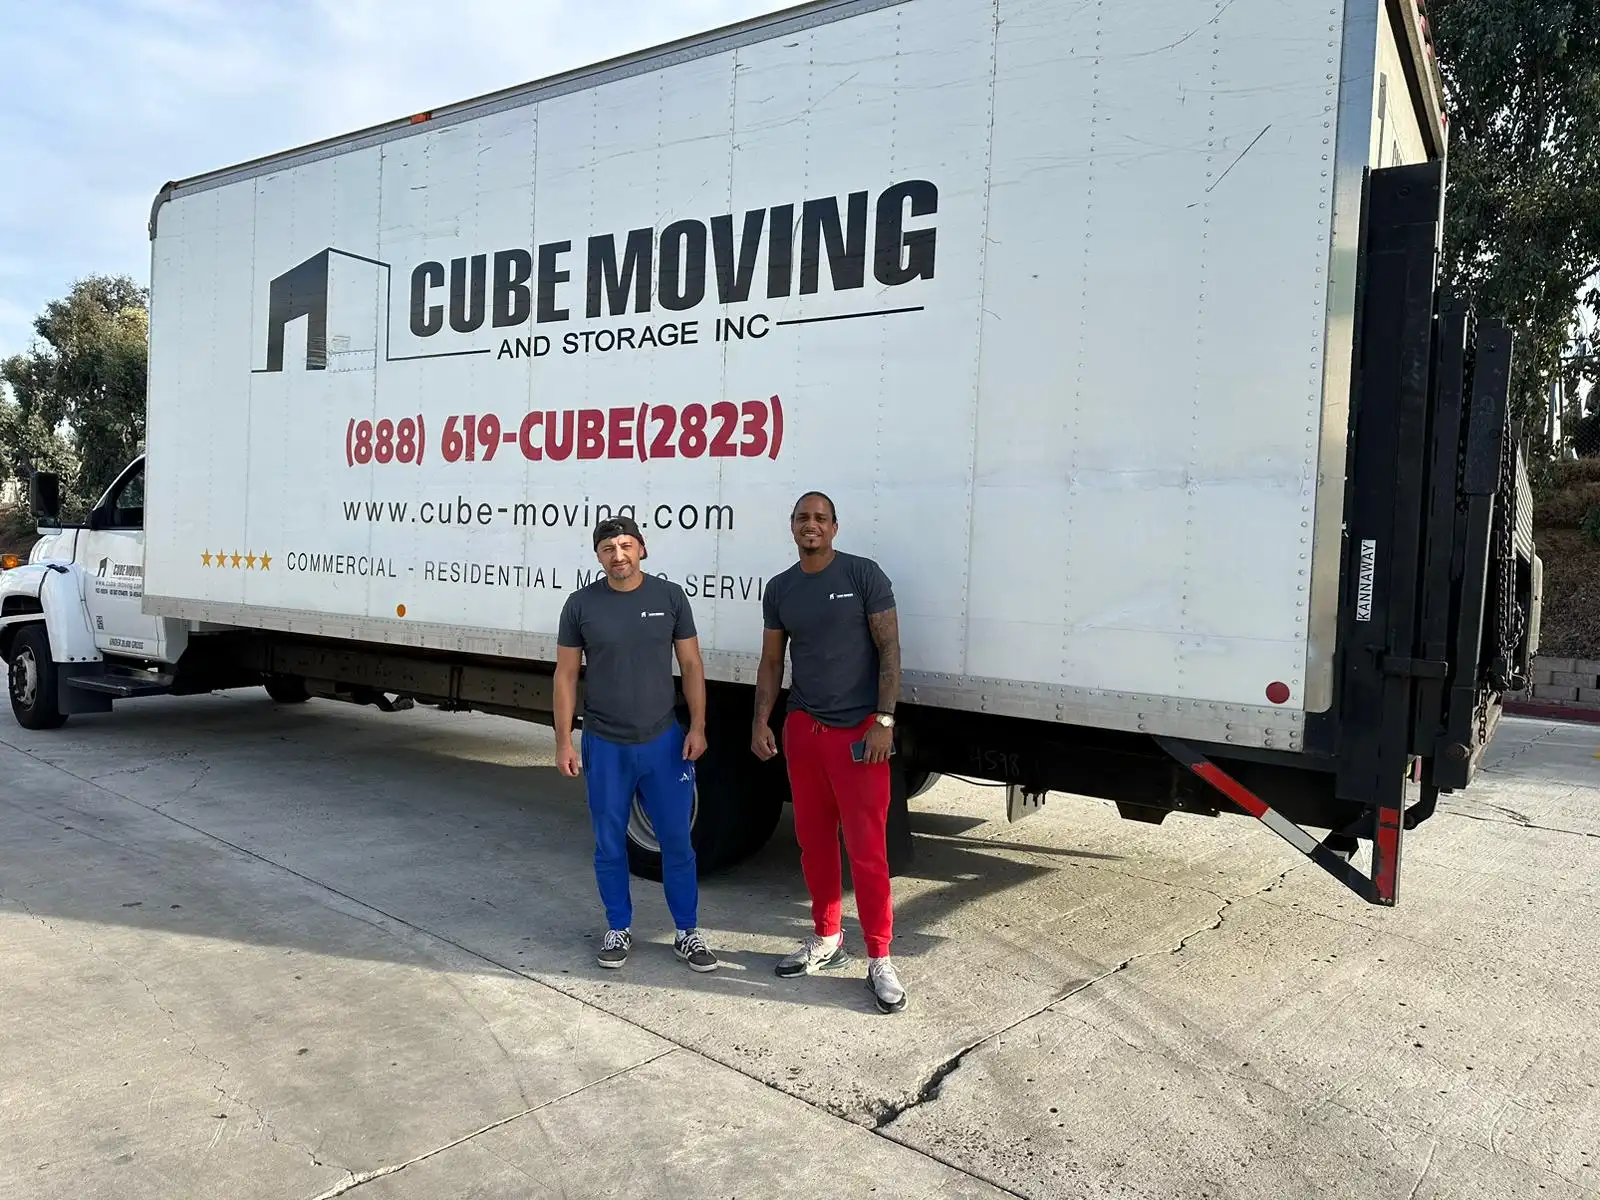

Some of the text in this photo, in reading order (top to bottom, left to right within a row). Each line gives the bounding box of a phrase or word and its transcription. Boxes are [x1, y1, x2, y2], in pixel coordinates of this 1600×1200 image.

[409, 179, 939, 337] CUBE MOVING
[496, 314, 770, 360] AND STORAGE INC
[346, 394, 784, 467] (888) 619-CUBE(2823)
[287, 551, 397, 578] COMMERCIAL
[424, 560, 563, 590] RESIDENTIAL
[685, 574, 762, 602] SERVI
[1357, 543, 1374, 620] KANNAWAY
